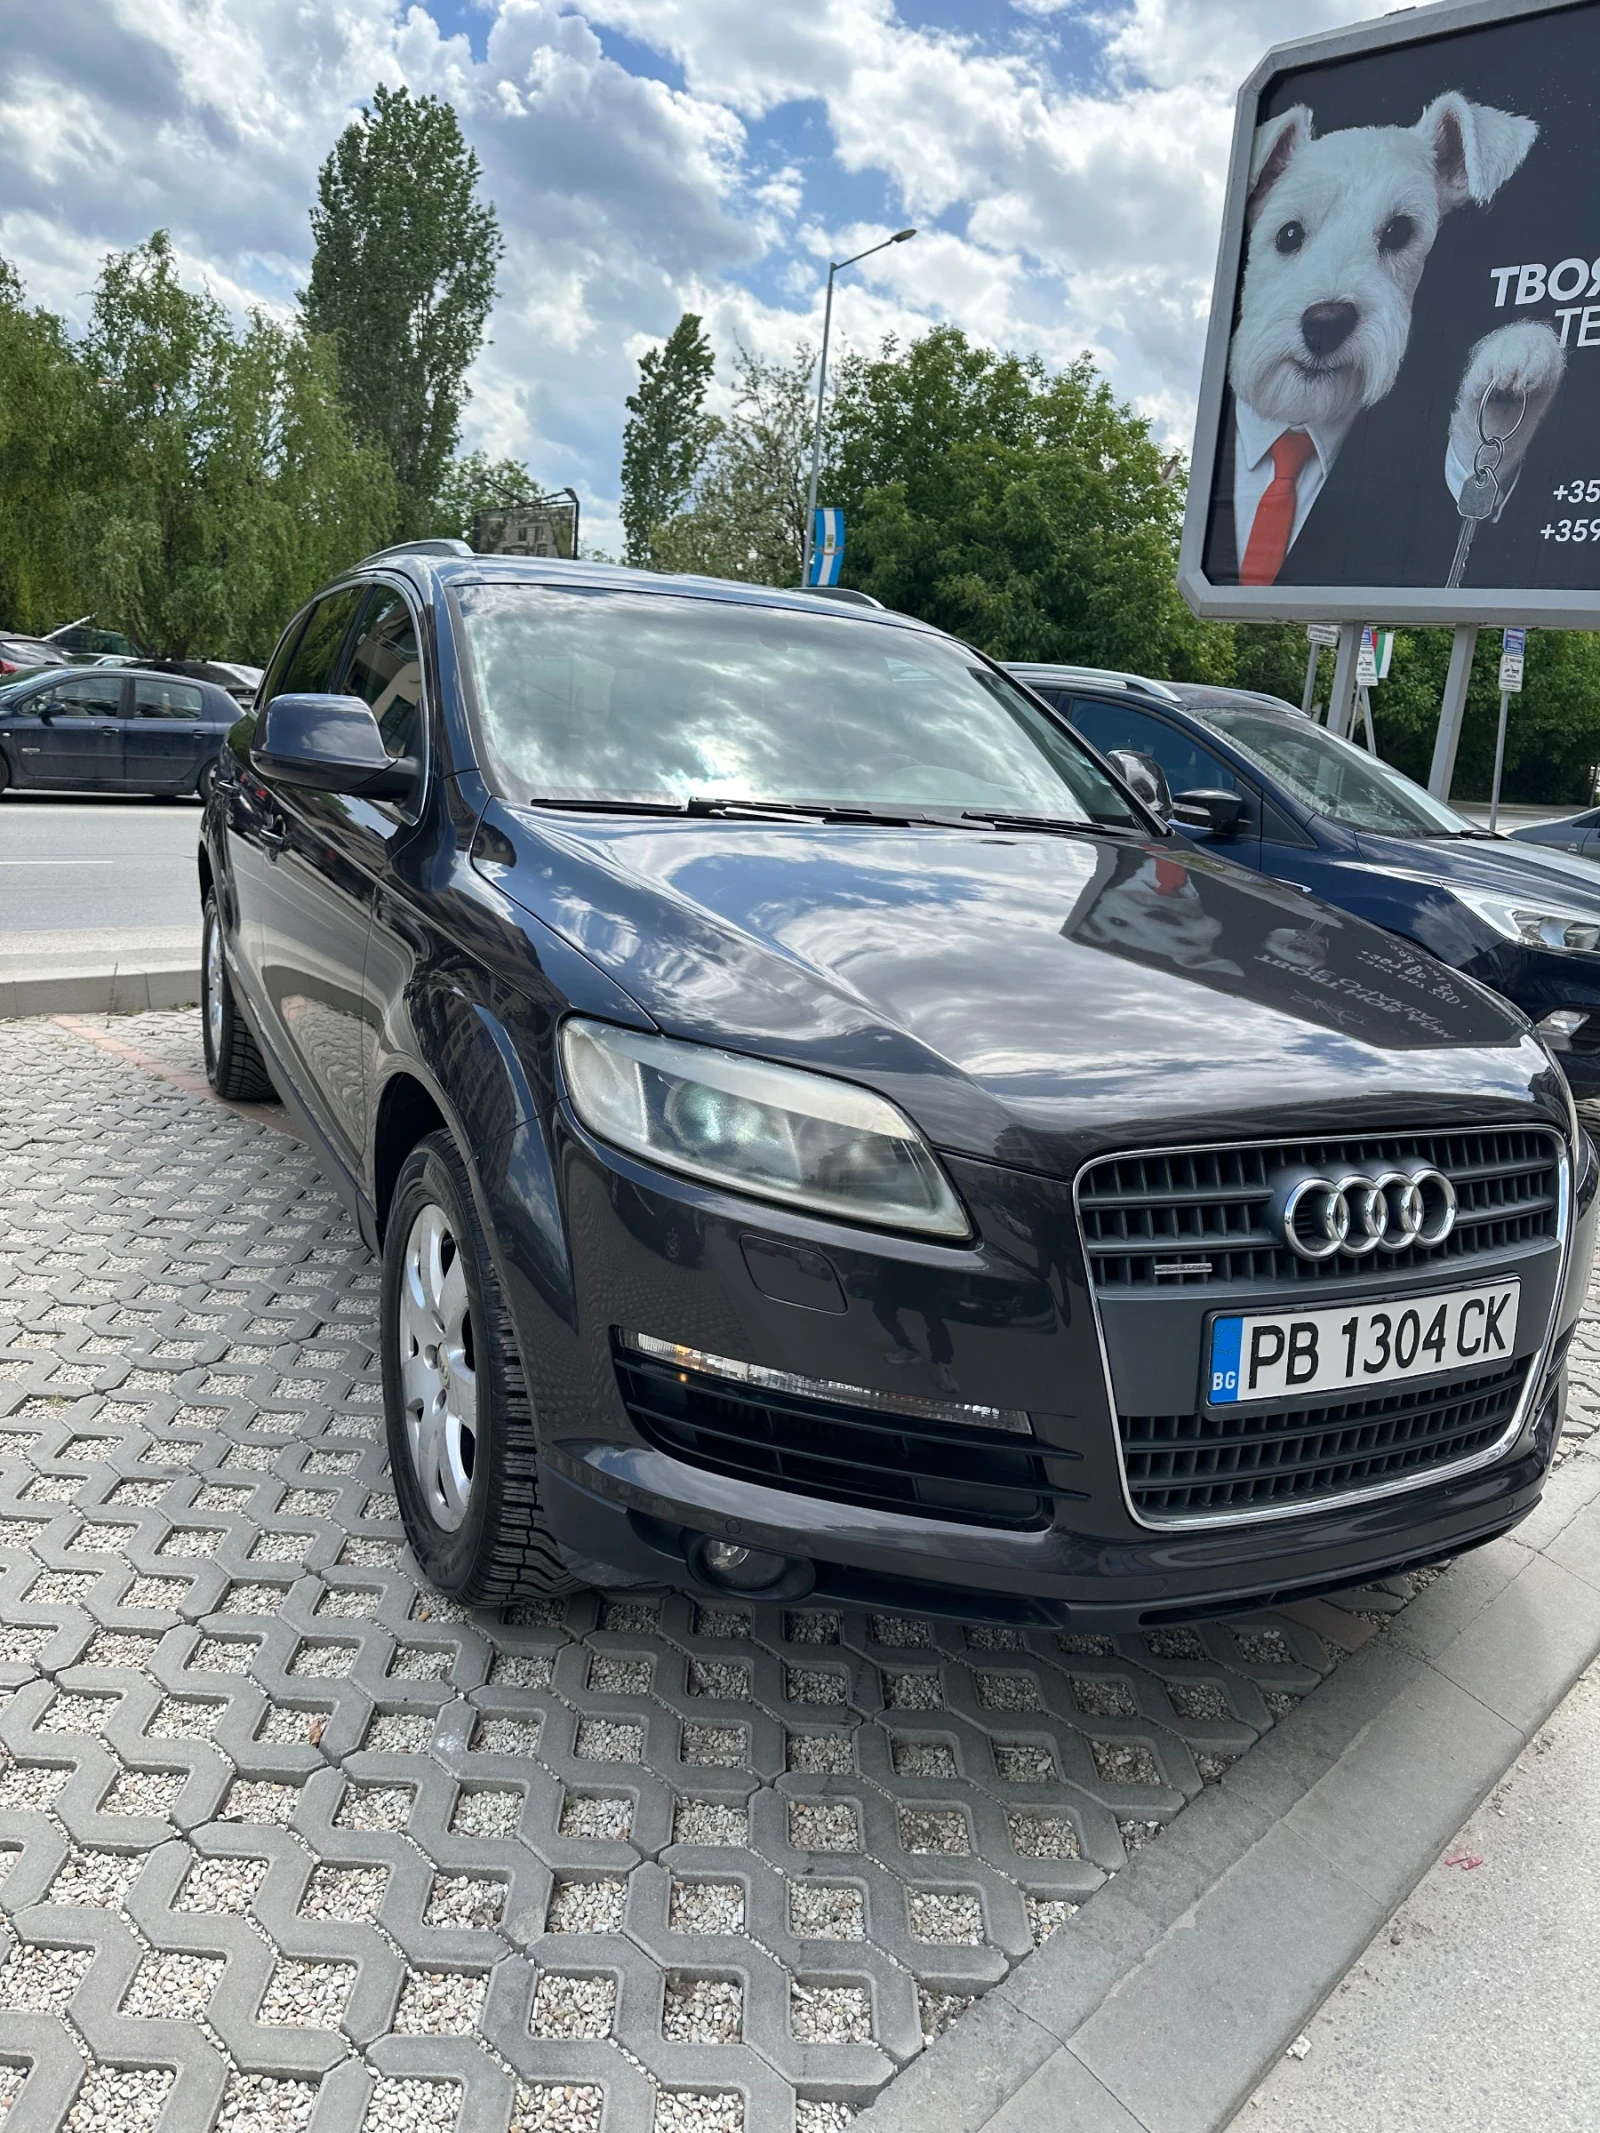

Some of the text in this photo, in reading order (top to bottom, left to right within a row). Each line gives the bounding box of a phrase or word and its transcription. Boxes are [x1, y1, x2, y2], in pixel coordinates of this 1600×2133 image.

[1555, 305, 1600, 348] ТЕ
[1553, 479, 1600, 503] +35
[1540, 518, 1600, 542] +359
[1248, 1292, 1512, 1389] PB 1304 CK
[1211, 1371, 1236, 1391] BG
